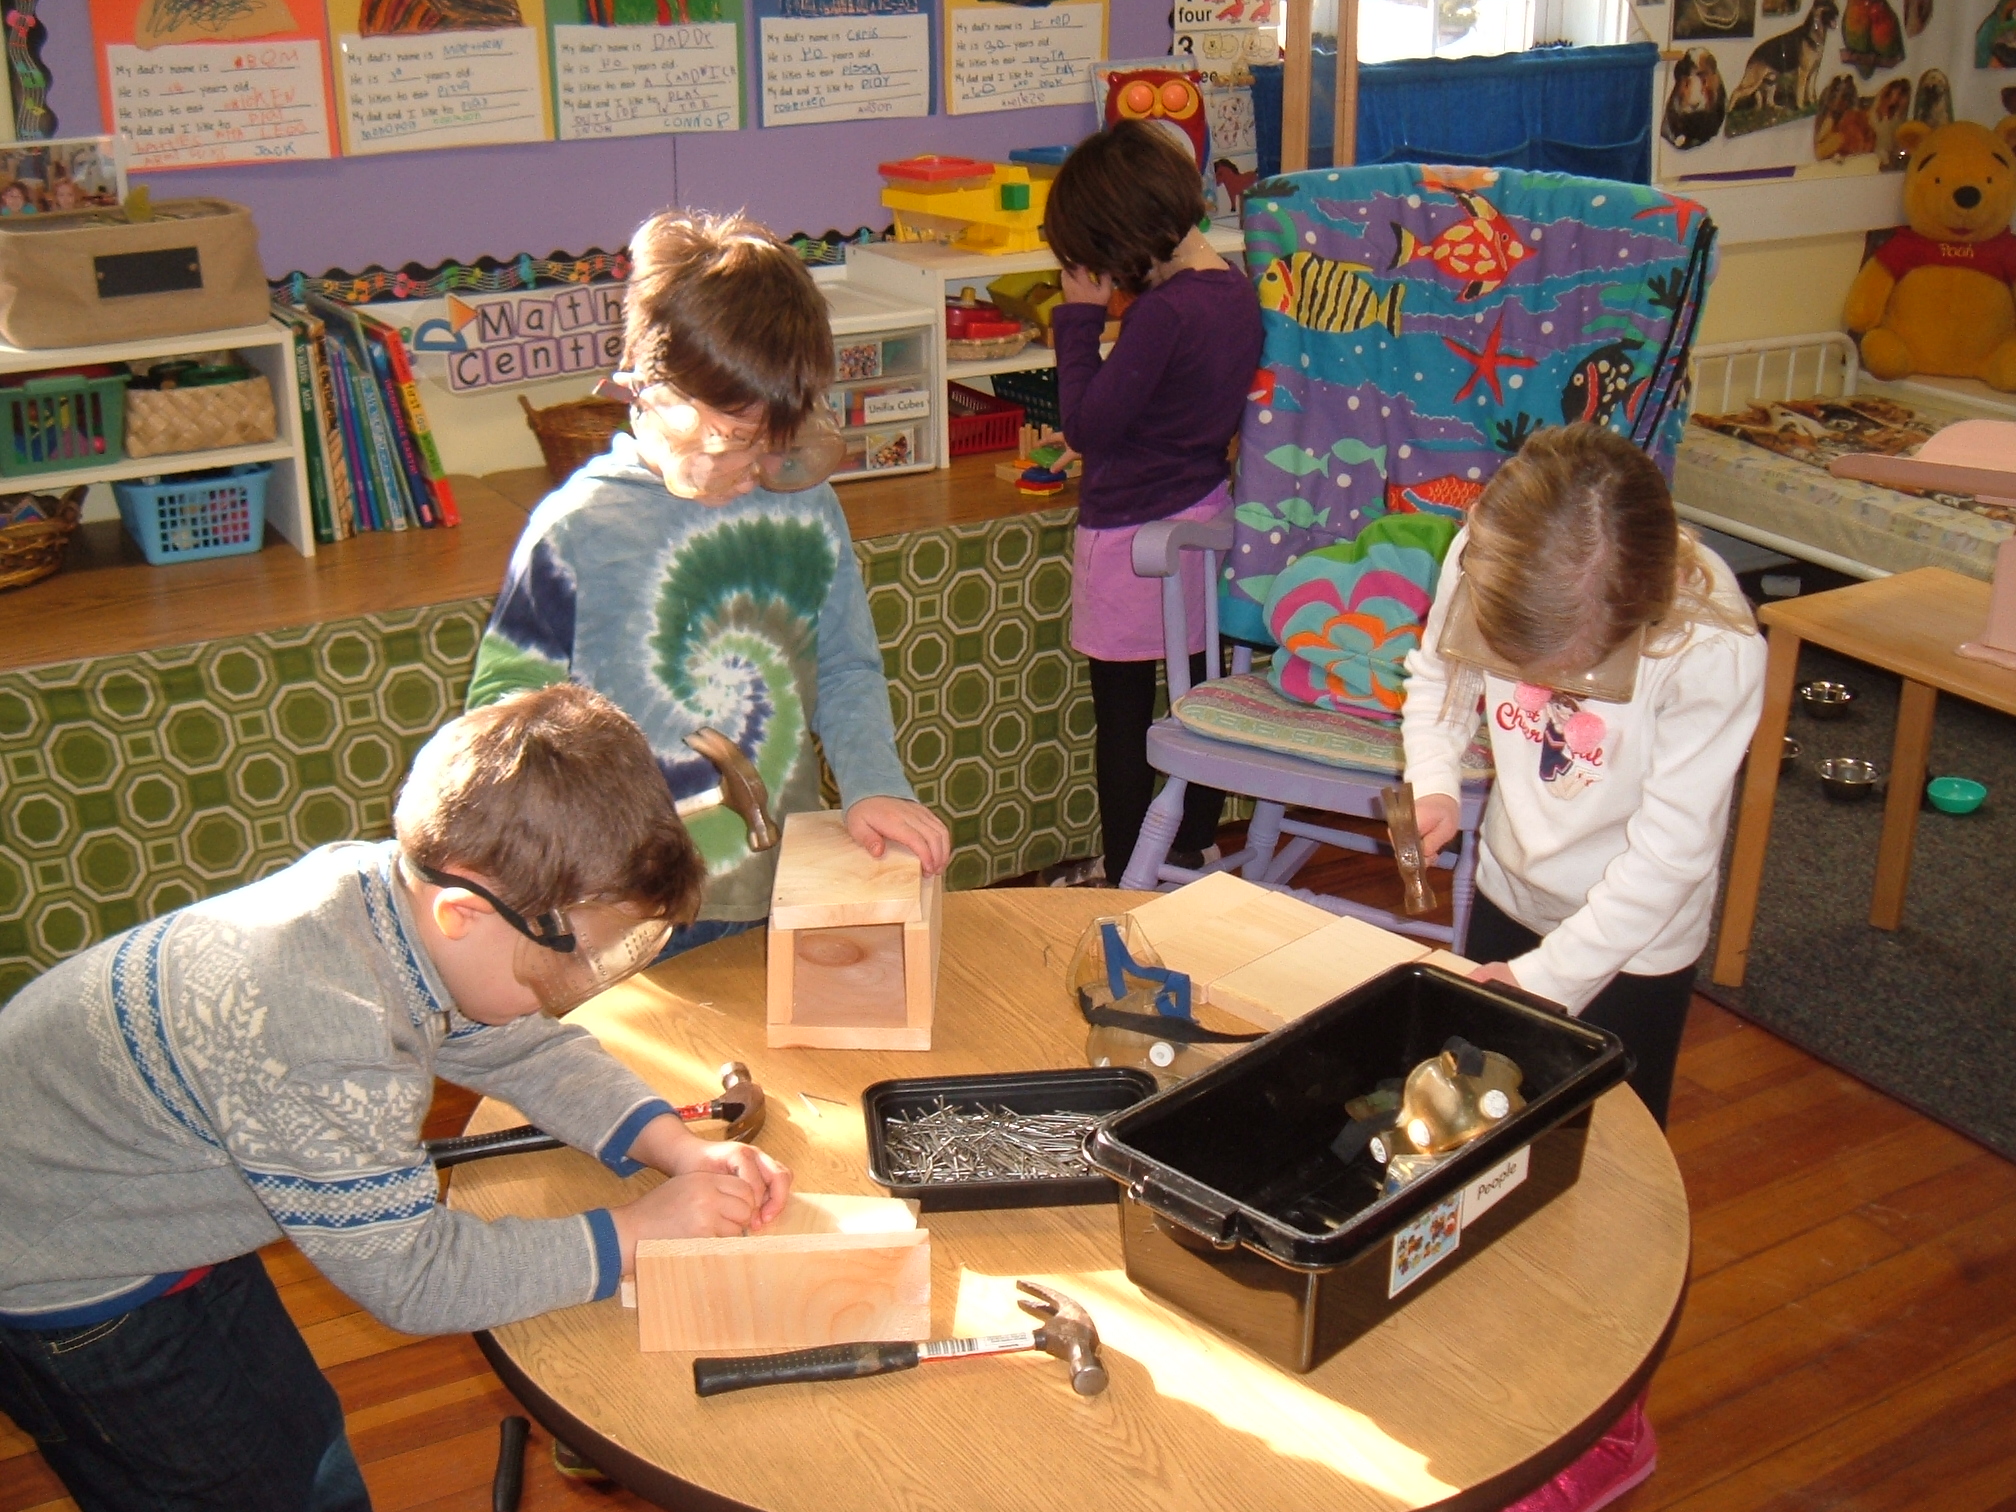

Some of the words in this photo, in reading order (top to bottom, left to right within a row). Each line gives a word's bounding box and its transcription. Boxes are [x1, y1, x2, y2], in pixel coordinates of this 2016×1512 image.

[1179, 7, 1212, 23] four
[957, 23, 967, 33] My
[768, 34, 779, 44] My
[809, 34, 828, 42] name
[832, 33, 840, 41] is
[1178, 35, 1193, 54] 3
[561, 44, 574, 54] My
[348, 53, 361, 65] My
[397, 53, 419, 61] name
[424, 52, 433, 60] is
[116, 65, 131, 77] My
[170, 65, 194, 74] name
[199, 63, 209, 72] is
[579, 65, 590, 73] is
[807, 69, 815, 77] to
[368, 75, 378, 83] is
[606, 81, 616, 89] to
[956, 74, 964, 86] My
[967, 73, 978, 82] dad
[982, 73, 993, 81] and
[138, 87, 149, 97] is
[397, 91, 407, 100] to
[768, 87, 777, 99] My
[780, 86, 792, 95] dad
[797, 85, 809, 95] and
[168, 105, 181, 115] to
[564, 99, 574, 113] My
[578, 98, 591, 108] dad
[596, 97, 609, 107] and
[647, 94, 657, 103] to
[352, 111, 364, 125] My
[367, 111, 382, 121] dad
[387, 110, 401, 120] and
[442, 105, 454, 114] to
[120, 125, 133, 139] My
[137, 123, 153, 135] dad
[158, 123, 174, 134] and
[220, 120, 230, 129] to
[481, 294, 622, 335] Math
[457, 336, 623, 385] Cente
[405, 384, 420, 410] first
[868, 403, 895, 414] Unifix
[897, 399, 924, 411] Cubes
[1476, 1160, 1517, 1200] People
